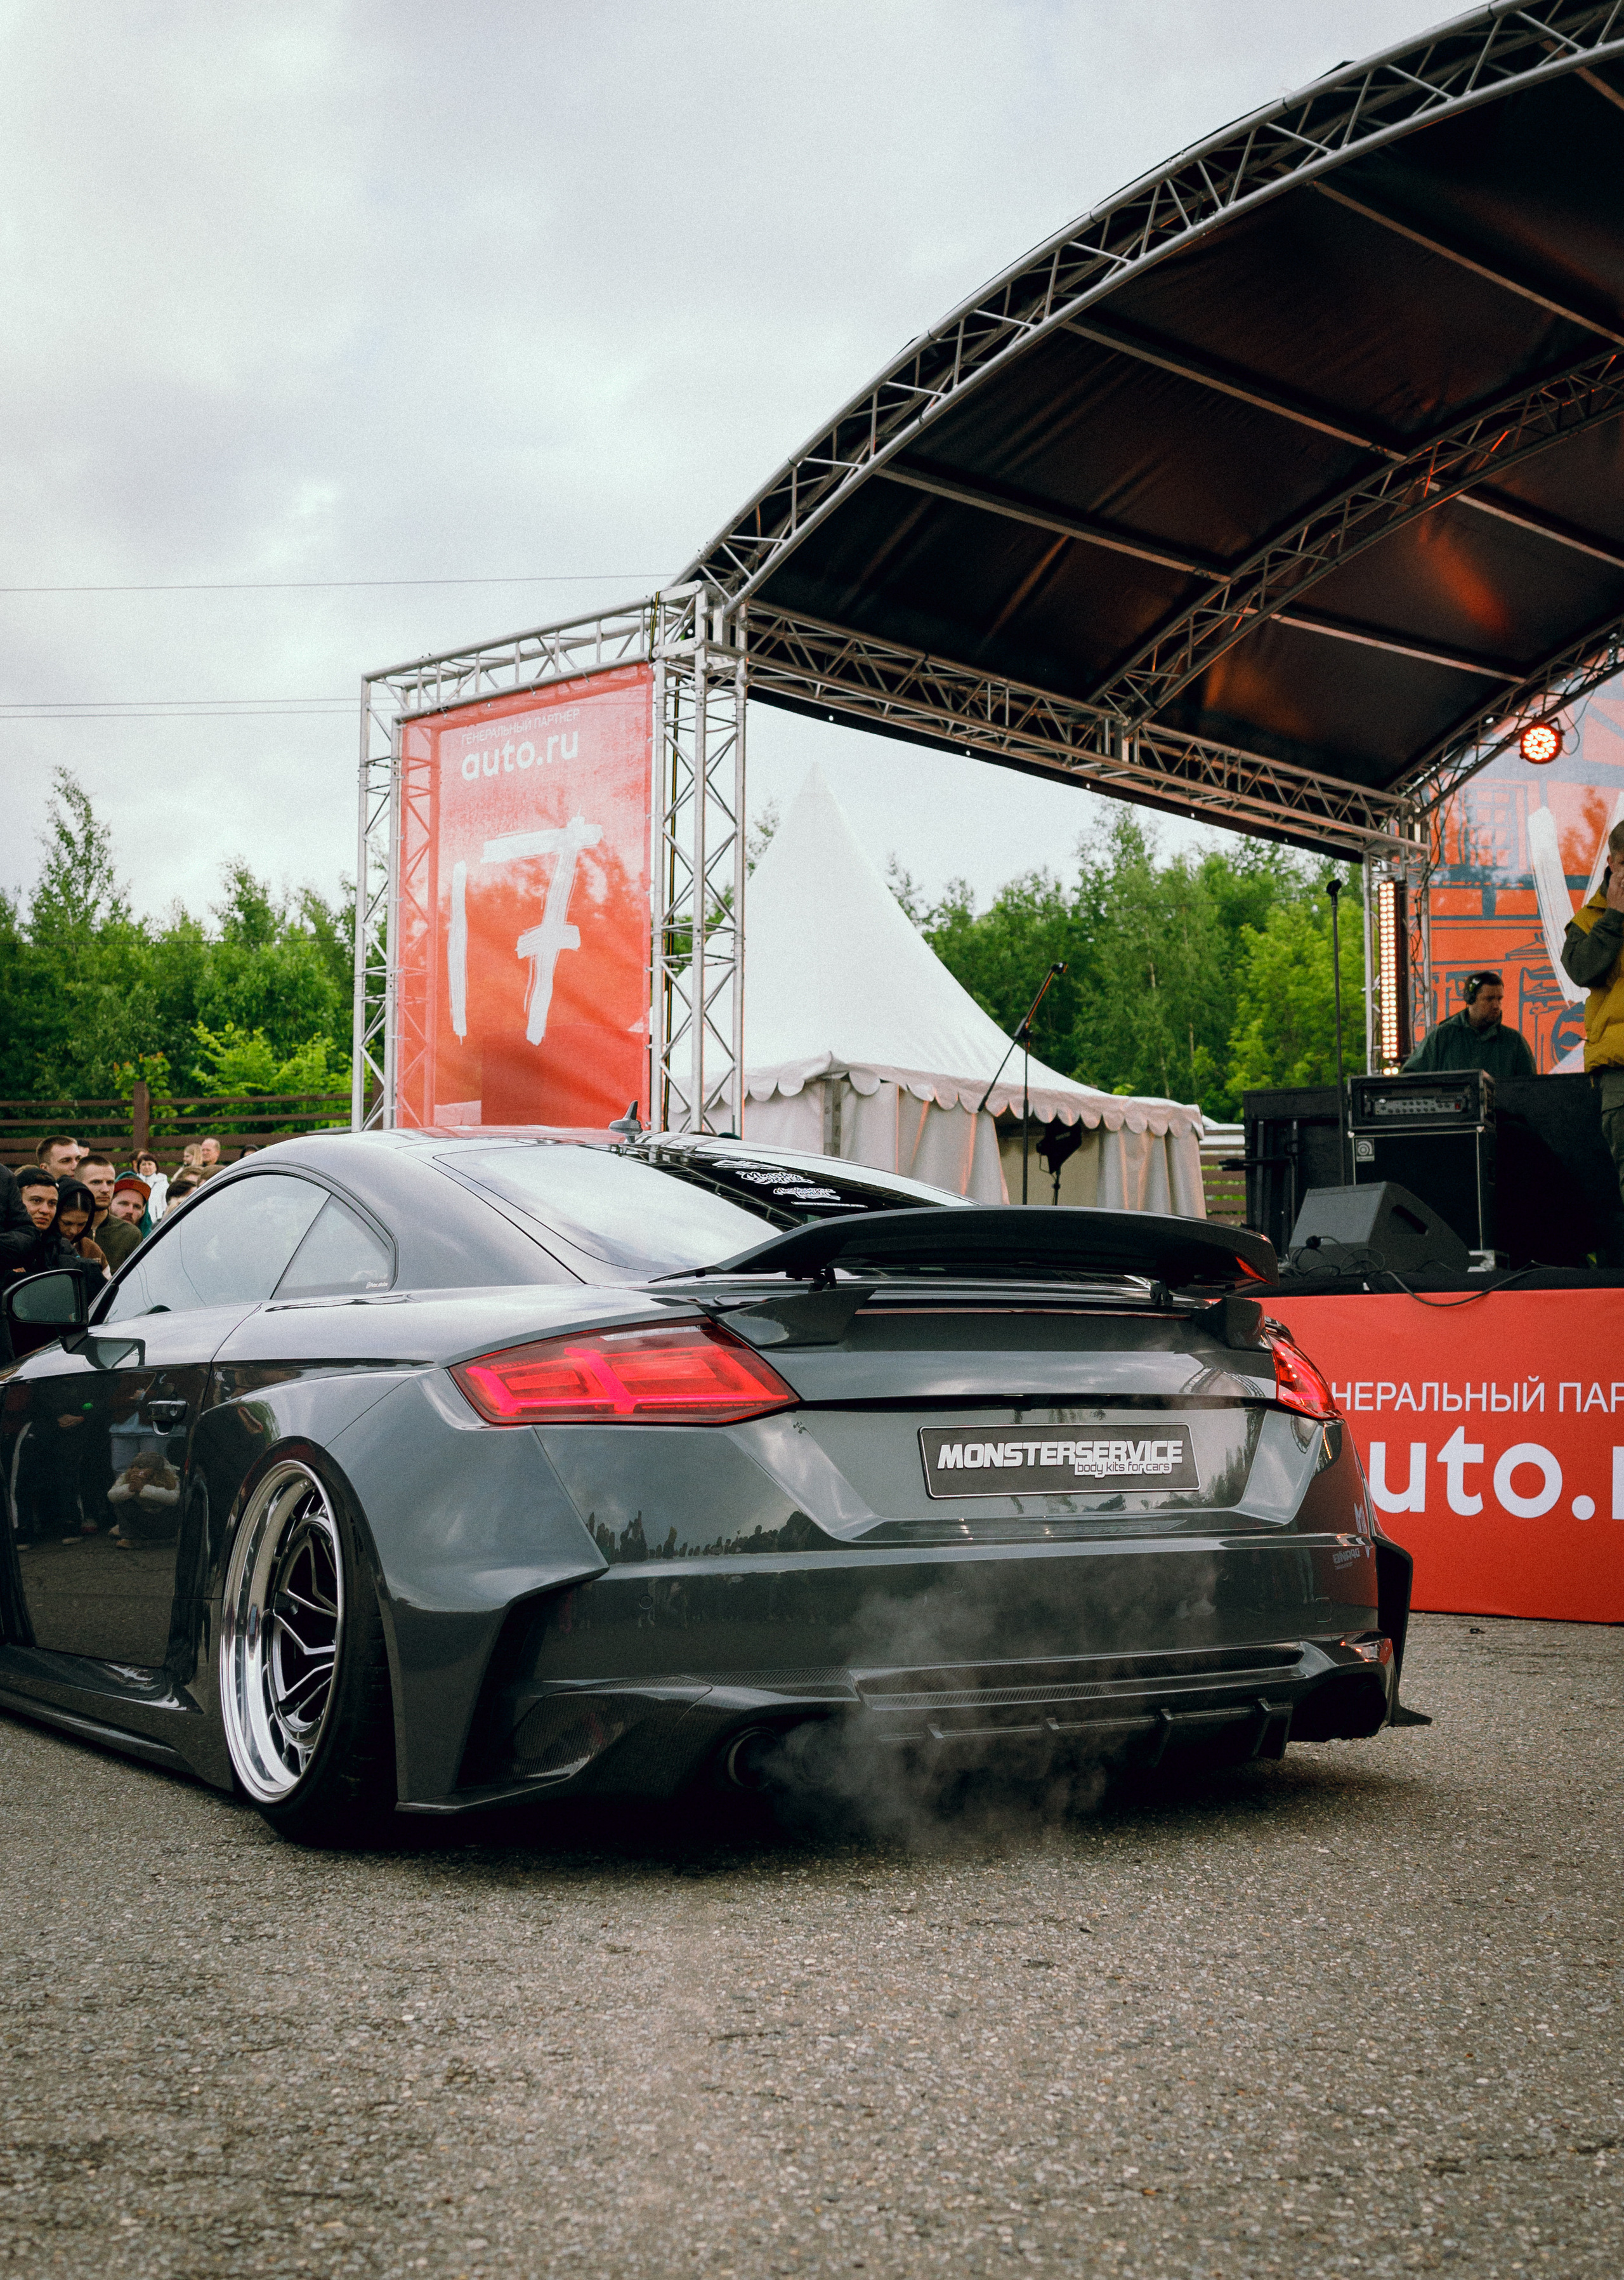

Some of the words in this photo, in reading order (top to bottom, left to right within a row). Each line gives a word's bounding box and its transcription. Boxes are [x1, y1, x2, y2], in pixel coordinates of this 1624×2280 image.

[461, 719, 532, 745] ГЕНЕРАЛЬНЫЙ
[534, 708, 580, 729] ПАРТНЕР
[461, 730, 579, 781] auto.ru
[1327, 1376, 1545, 1413] НЕРАЛЬНЫЙ
[937, 1440, 1183, 1470] MONSTERSERVICE
[1077, 1462, 1103, 1475] body
[1106, 1462, 1125, 1472] kits
[1128, 1461, 1143, 1472] for
[1146, 1462, 1170, 1472] cars
